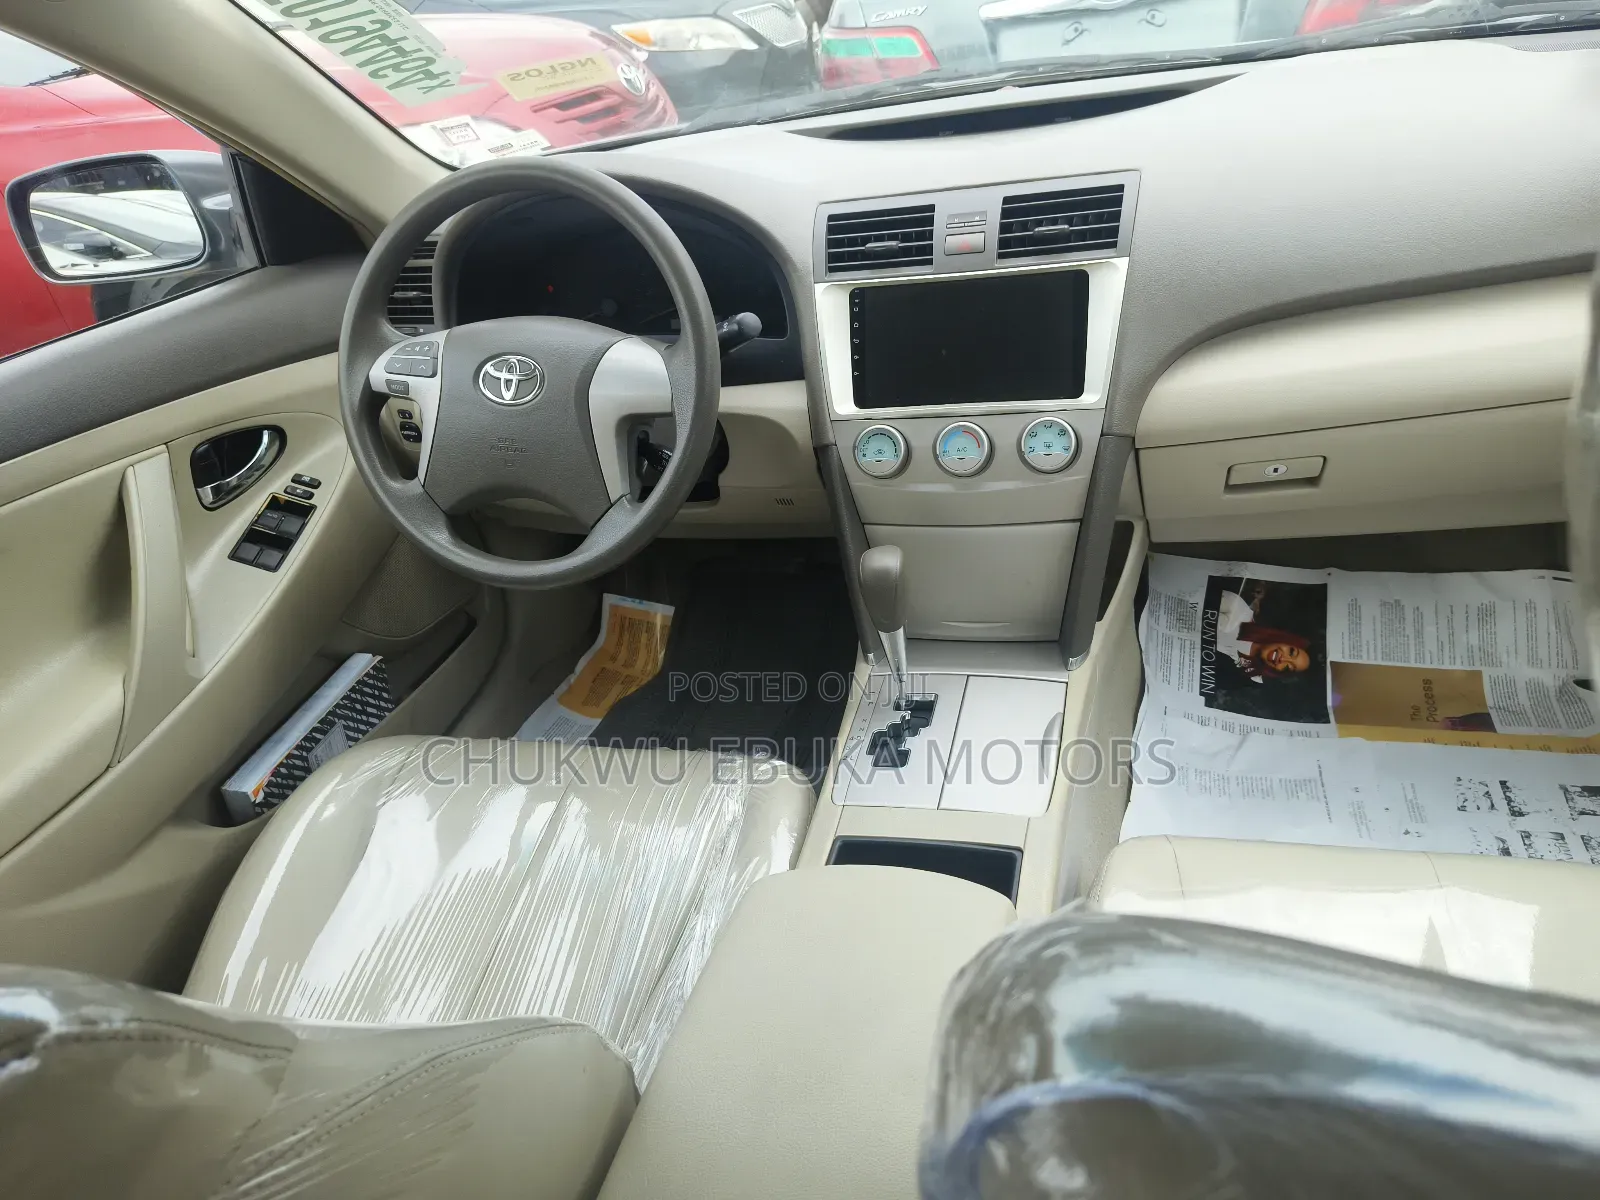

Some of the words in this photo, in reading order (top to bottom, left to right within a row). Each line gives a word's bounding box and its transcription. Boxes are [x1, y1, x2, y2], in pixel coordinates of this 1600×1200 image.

[1203, 609, 1218, 641] RUN
[1201, 641, 1216, 662] TO
[1200, 663, 1216, 694] WIN
[1409, 704, 1422, 722] The
[1422, 677, 1440, 723] Process
